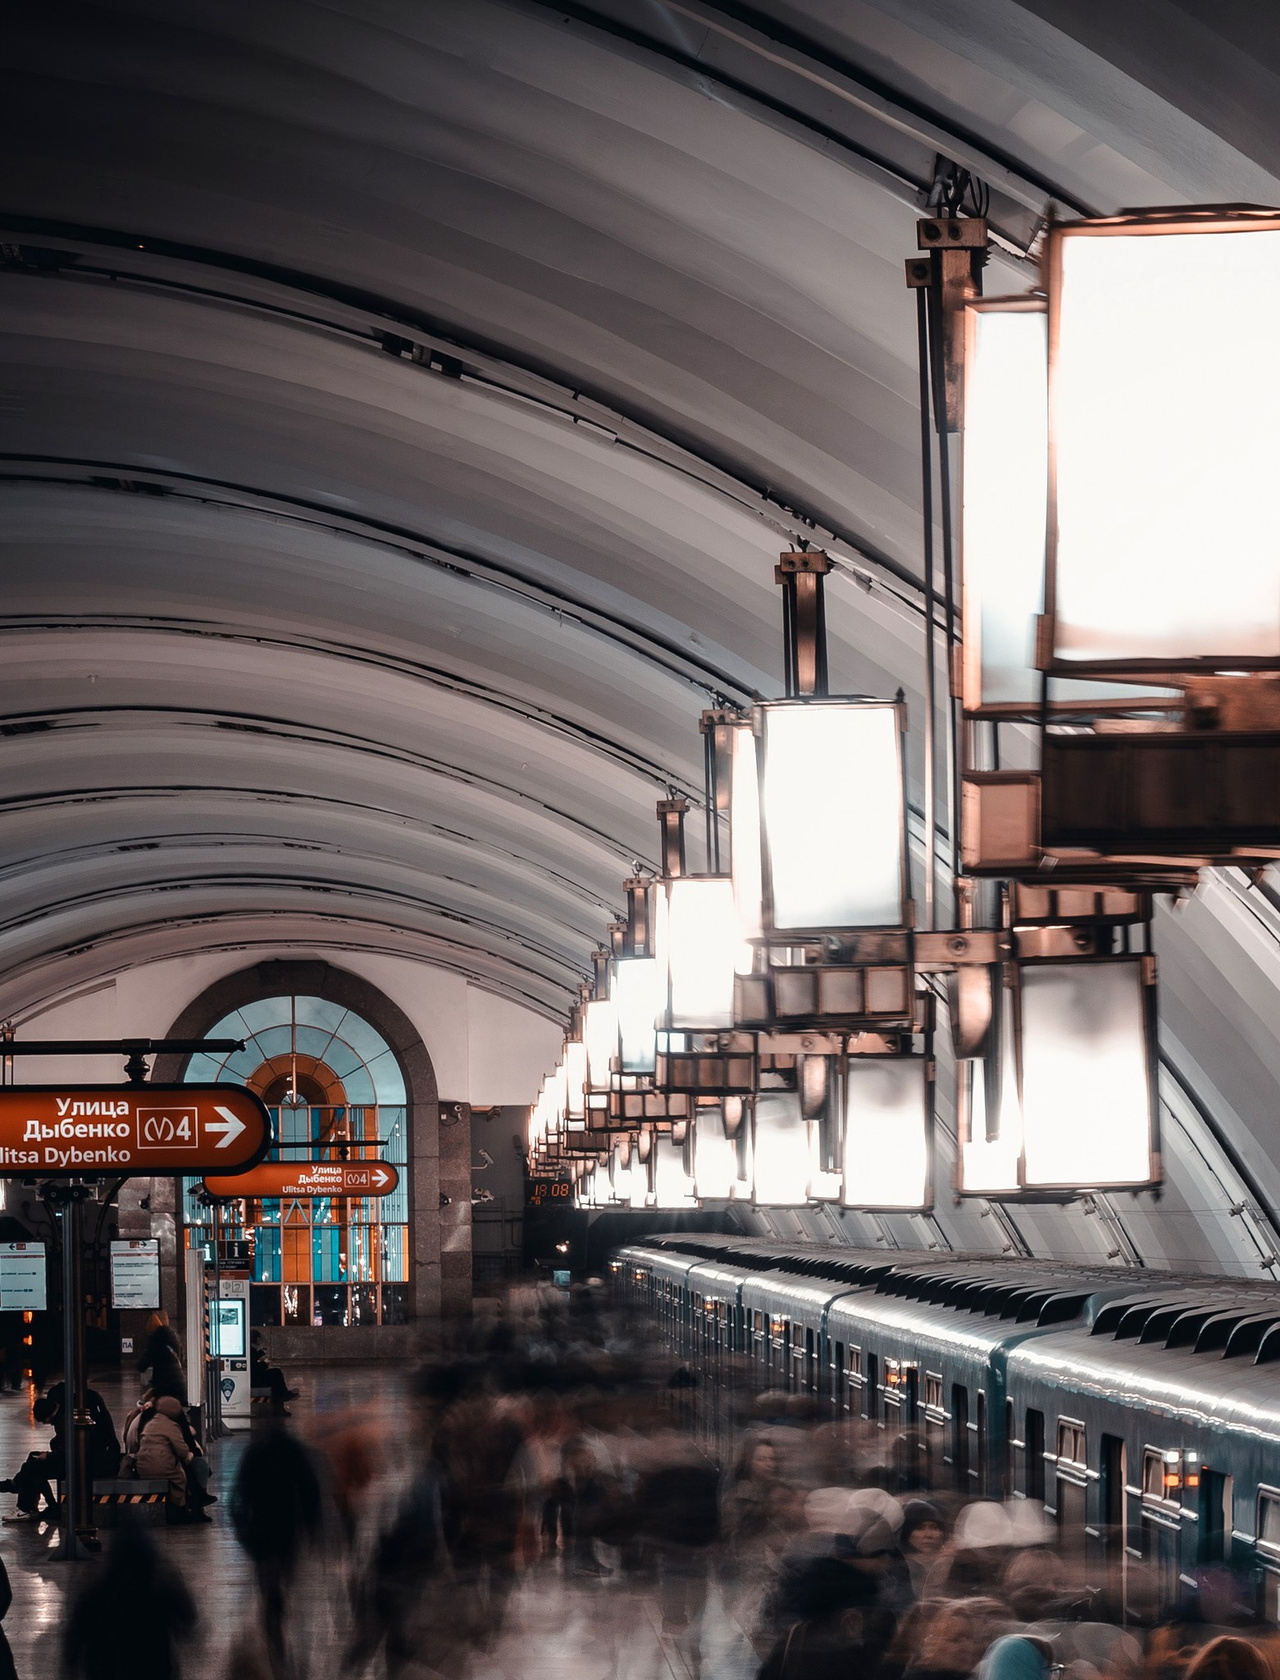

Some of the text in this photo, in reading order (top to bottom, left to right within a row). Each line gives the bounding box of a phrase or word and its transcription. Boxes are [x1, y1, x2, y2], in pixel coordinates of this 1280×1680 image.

[56, 1098, 129, 1118] Улица
[23, 1118, 130, 1142] Дыбенко
[44, 1146, 131, 1167] Dybenko
[311, 1166, 342, 1174] Улица
[298, 1174, 342, 1184] Дыбенко
[307, 1185, 342, 1194] Dybenko
